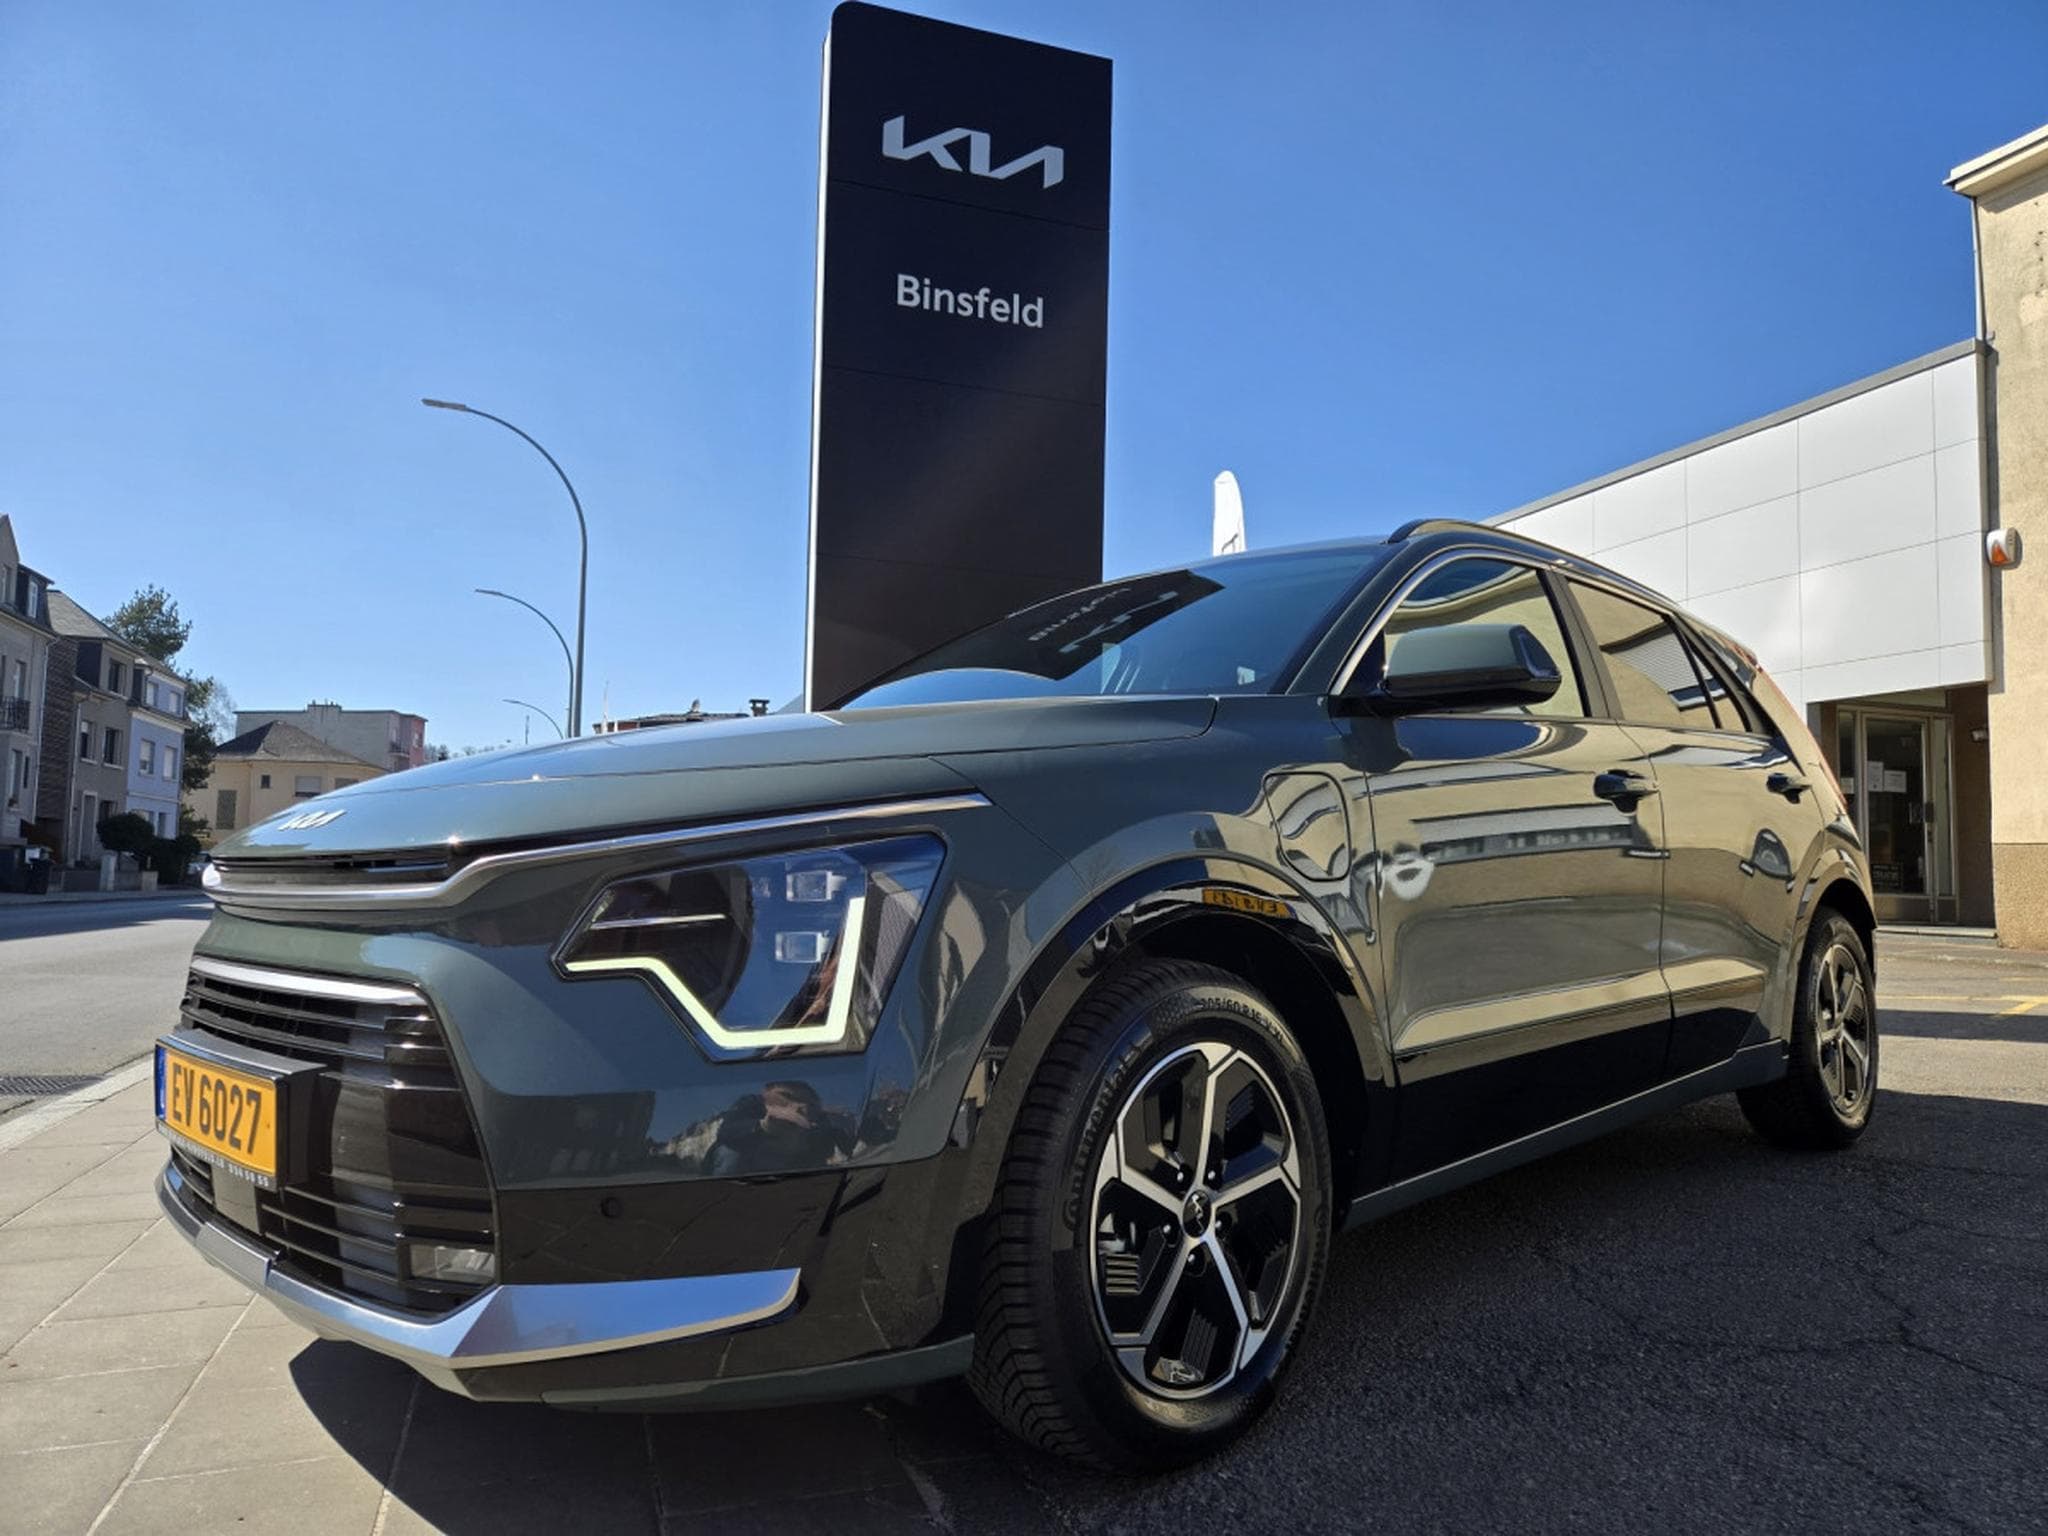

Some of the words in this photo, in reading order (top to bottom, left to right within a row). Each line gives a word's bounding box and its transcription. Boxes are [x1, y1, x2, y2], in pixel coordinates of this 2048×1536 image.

[882, 115, 1064, 189] KIA
[896, 273, 1045, 328] Binsfeld
[173, 1062, 195, 1127] EV
[199, 1074, 262, 1155] 6027
